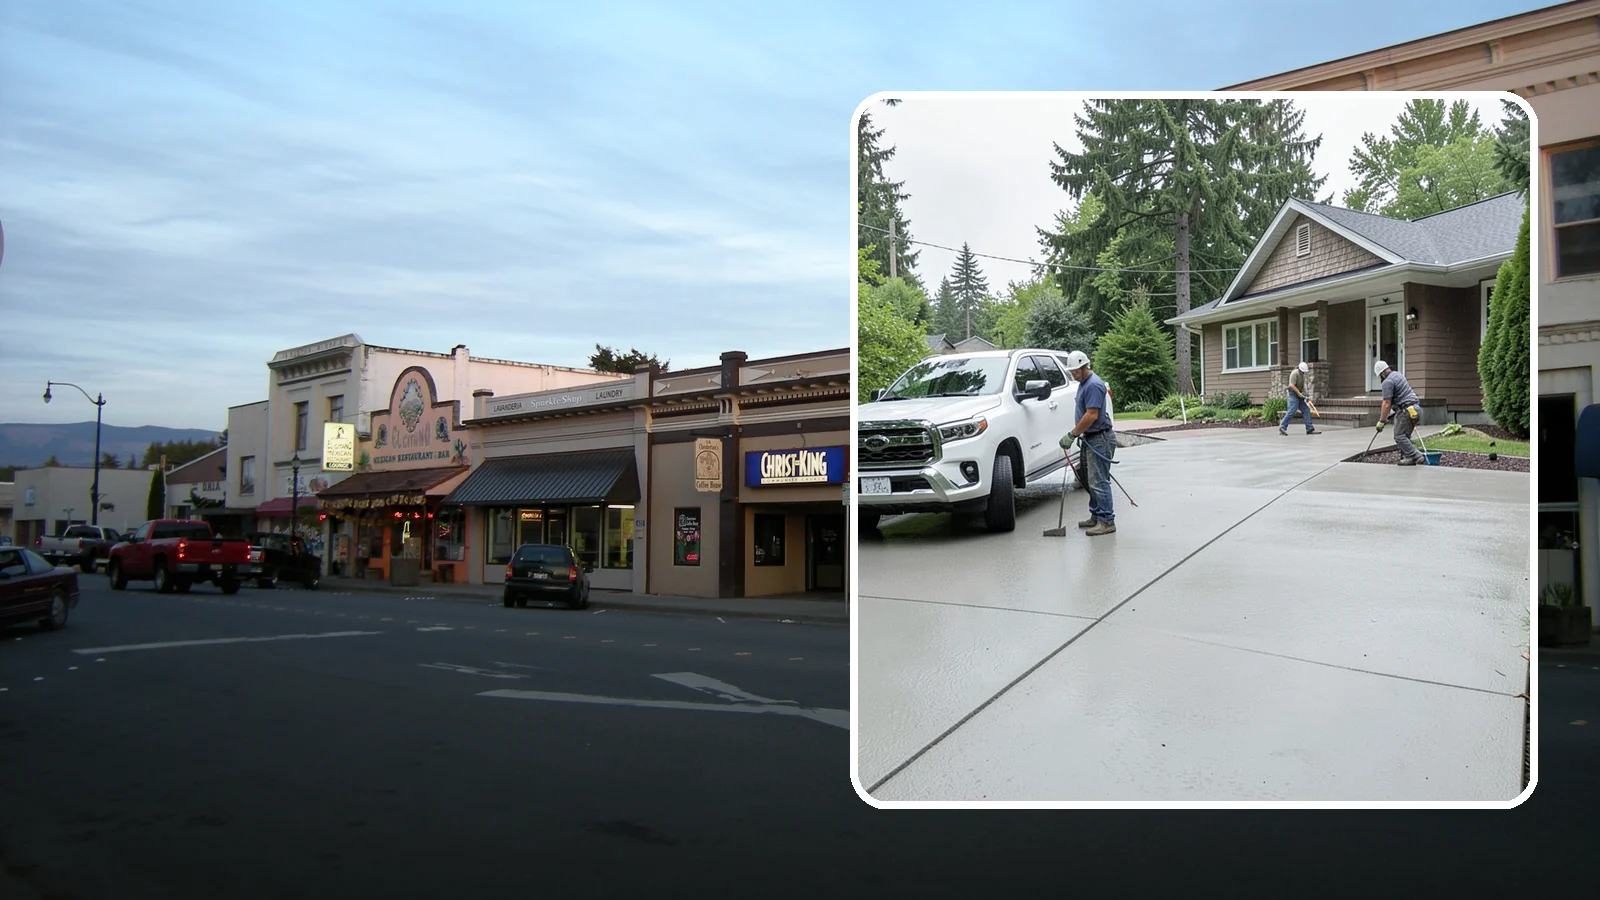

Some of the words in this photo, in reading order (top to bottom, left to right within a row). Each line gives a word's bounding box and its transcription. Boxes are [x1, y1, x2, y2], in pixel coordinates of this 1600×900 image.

[531, 396, 561, 409] Sparkle
[562, 394, 582, 405] Shop
[595, 389, 623, 400] LAUNDRY
[493, 402, 522, 412] LAVANDERIA
[374, 455, 396, 464] MEXICAN
[397, 451, 434, 462] RESTAURANT
[437, 450, 450, 459] BAR
[761, 452, 797, 478] CHRIST
[799, 450, 827, 476] KING
